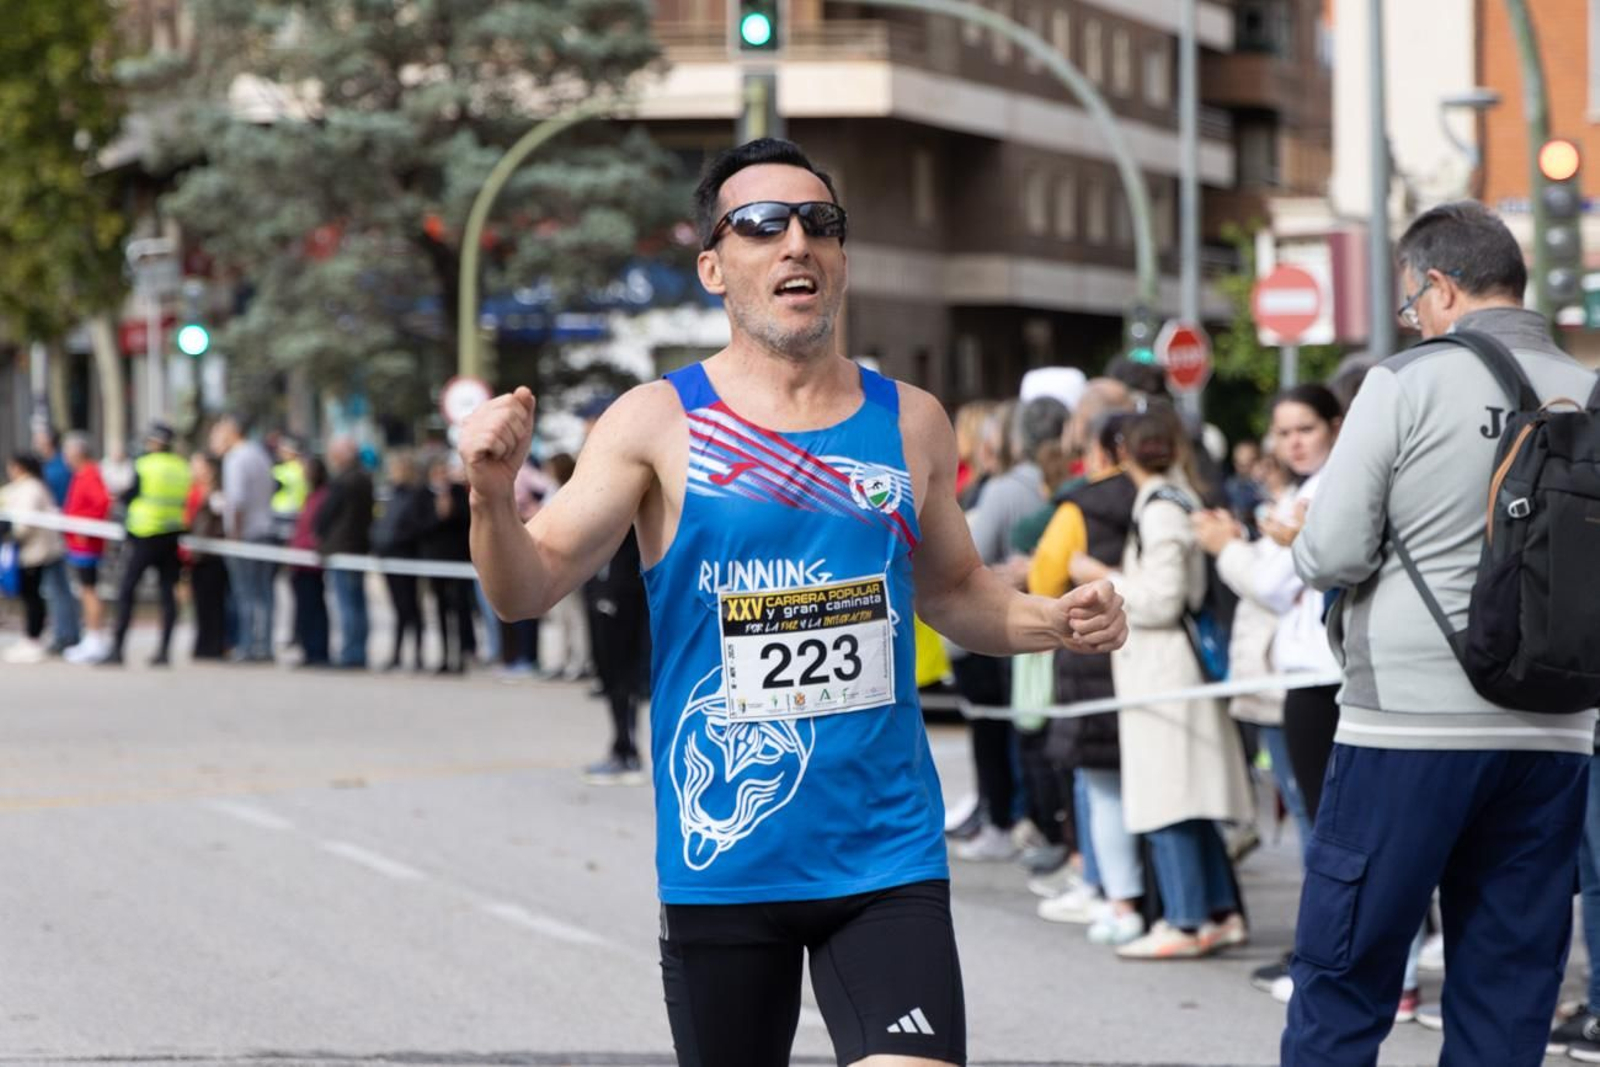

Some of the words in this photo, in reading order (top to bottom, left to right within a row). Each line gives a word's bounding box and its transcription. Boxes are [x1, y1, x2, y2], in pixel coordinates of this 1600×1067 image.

[698, 558, 833, 594] RUNNING
[765, 592, 827, 608] CARRERA
[828, 583, 881, 600] POPULAR
[766, 608, 775, 620] y
[783, 603, 818, 619] gran
[825, 594, 882, 612] caminata
[727, 597, 763, 622] XXV
[760, 633, 862, 690] 223
